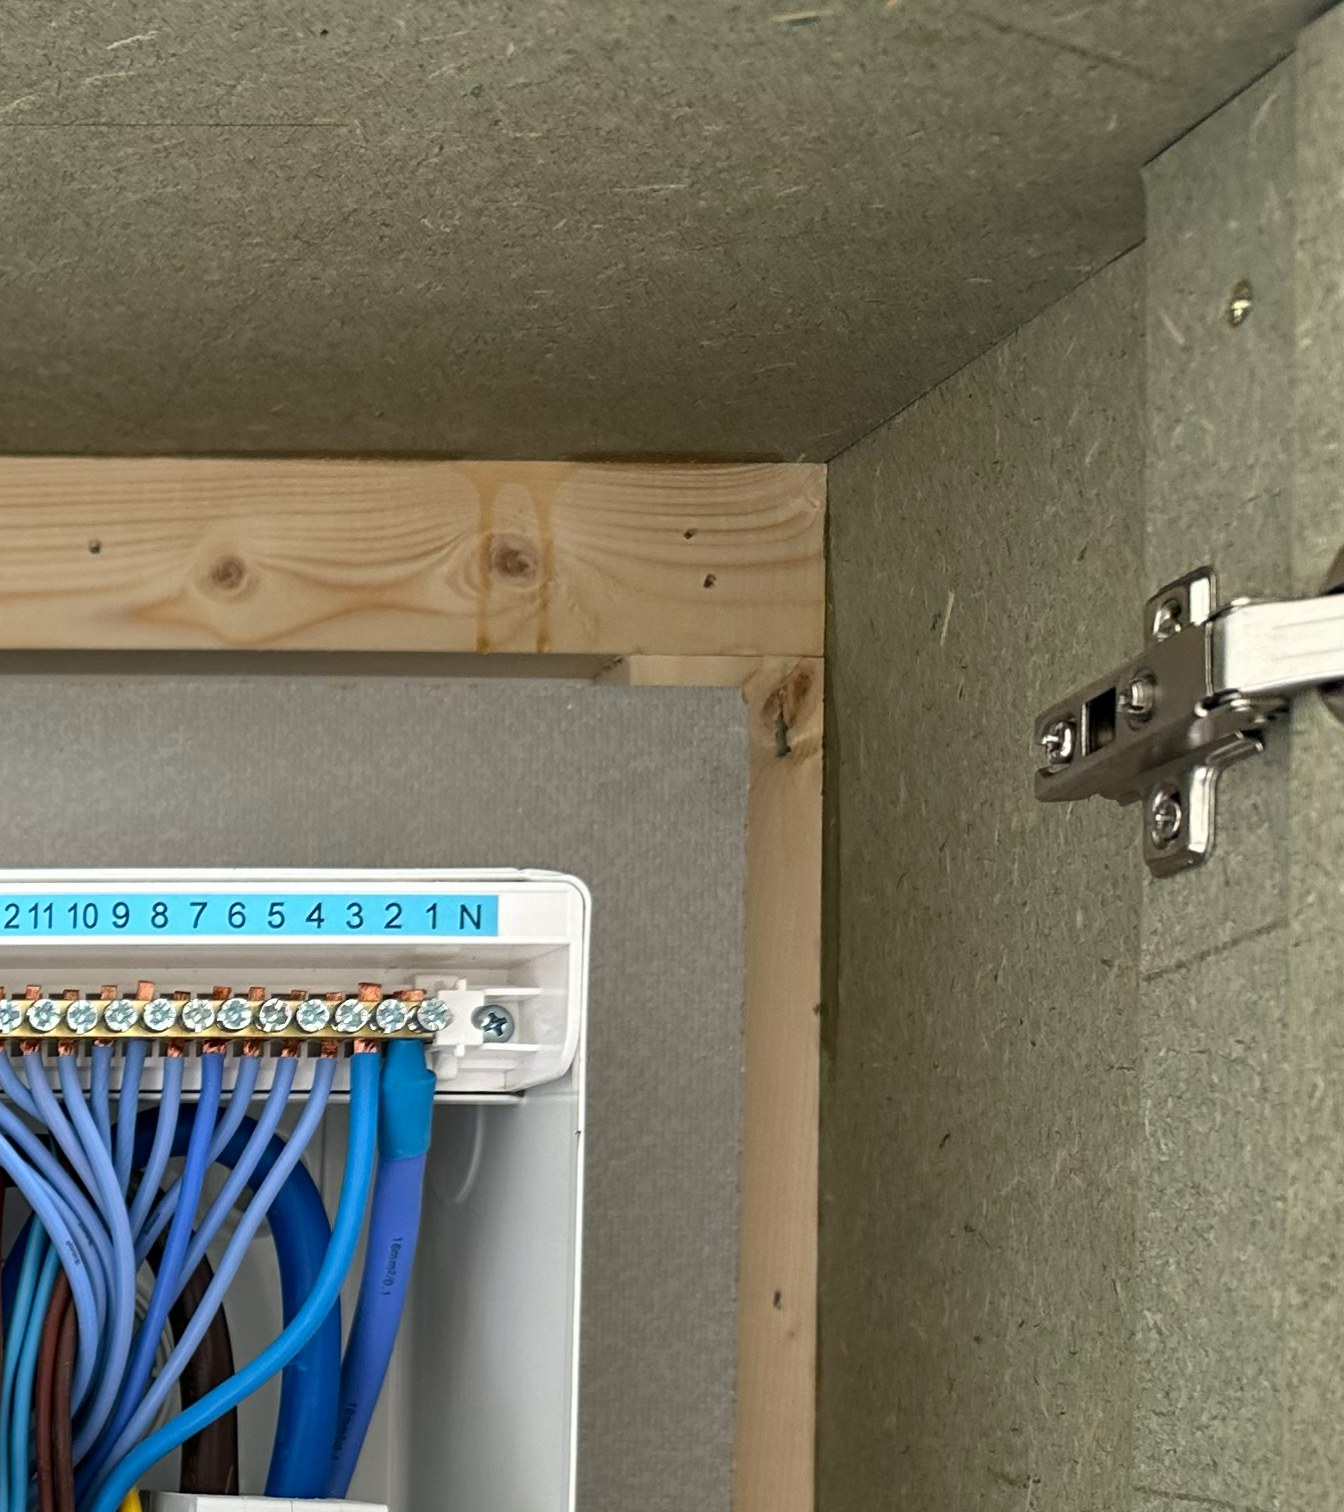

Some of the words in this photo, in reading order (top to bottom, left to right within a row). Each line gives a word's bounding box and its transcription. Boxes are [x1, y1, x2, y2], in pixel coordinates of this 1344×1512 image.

[29, 903, 53, 929] 11
[68, 903, 98, 929] 10
[112, 902, 129, 929] 9
[151, 902, 168, 929] 8
[190, 902, 208, 929] 7
[228, 902, 246, 929] 6
[268, 902, 285, 929] 5
[305, 902, 325, 929] 4
[346, 902, 363, 929] 3
[384, 903, 403, 929] 2
[426, 903, 437, 930] 1
[459, 904, 481, 930] N
